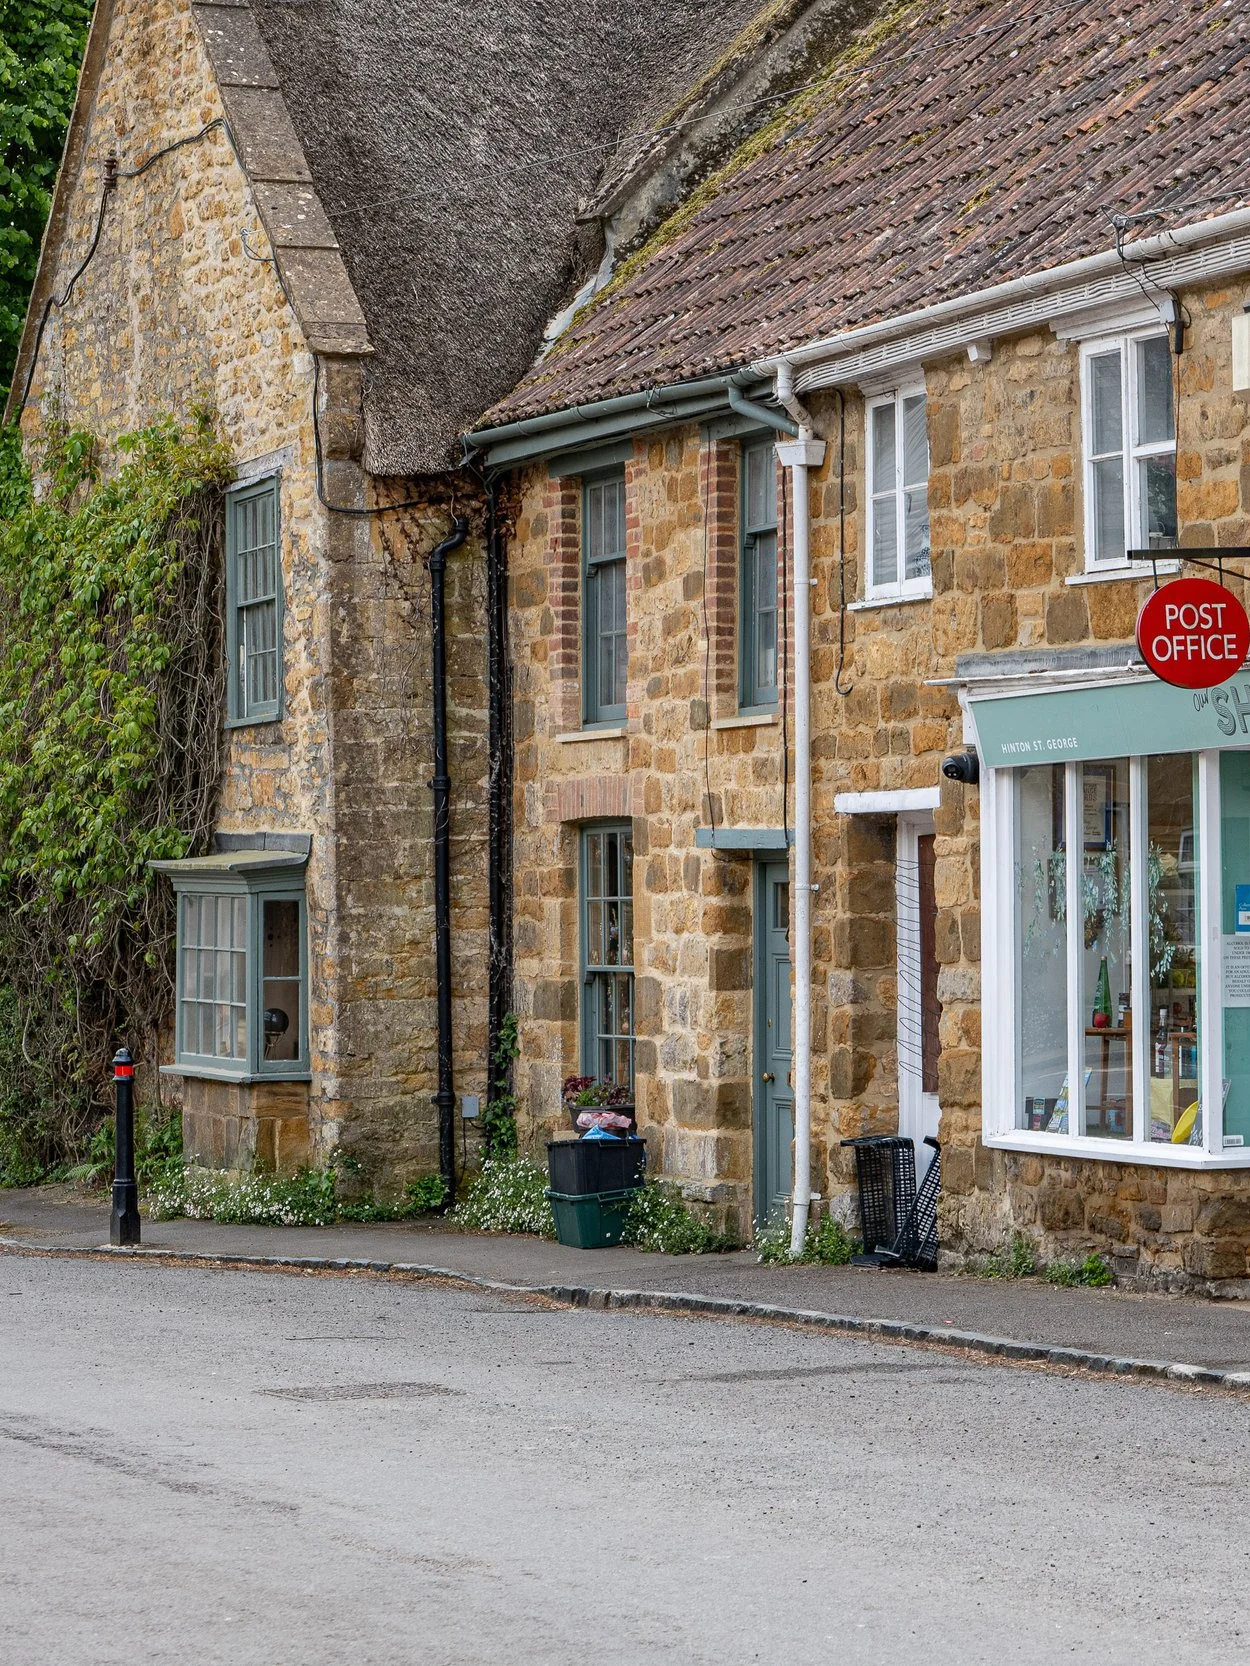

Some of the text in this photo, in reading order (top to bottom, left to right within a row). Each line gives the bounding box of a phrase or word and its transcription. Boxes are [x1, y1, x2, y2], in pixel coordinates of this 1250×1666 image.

[1165, 603, 1227, 630] POST
[1152, 634, 1238, 661] OFFICE
[1001, 737, 1078, 754] HINTON ST. GEORGE
